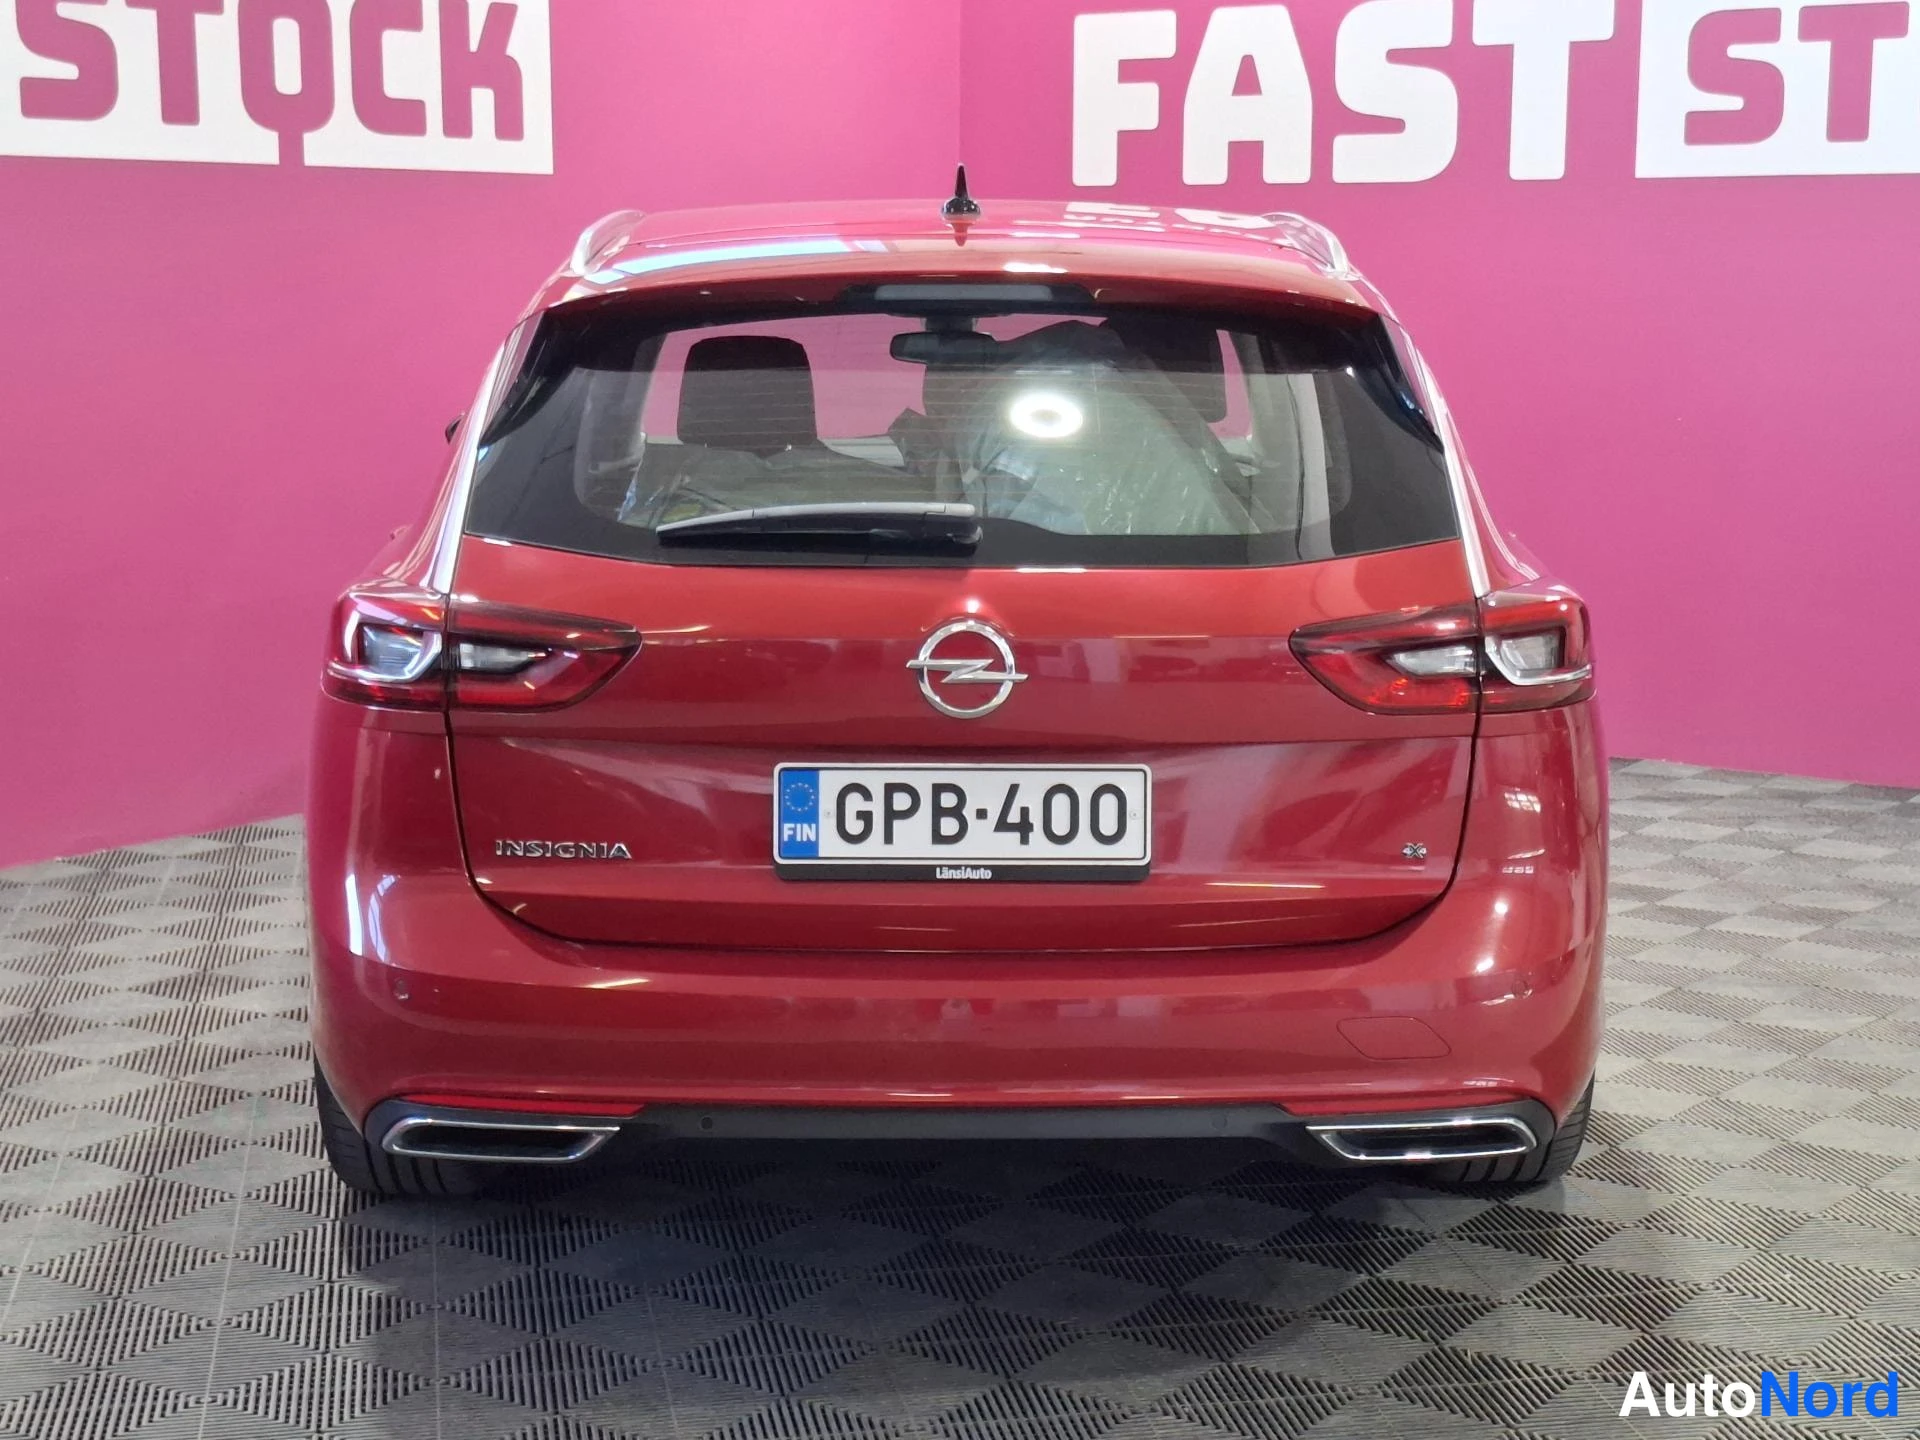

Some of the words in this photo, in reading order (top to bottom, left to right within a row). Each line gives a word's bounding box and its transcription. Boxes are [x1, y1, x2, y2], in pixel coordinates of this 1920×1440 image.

[1072, 0, 1615, 187] FAST
[836, 782, 1128, 846] GPB-400
[783, 823, 816, 842] FIN
[495, 839, 632, 859] INSIGNIA
[936, 866, 992, 880] LänsiAuto
